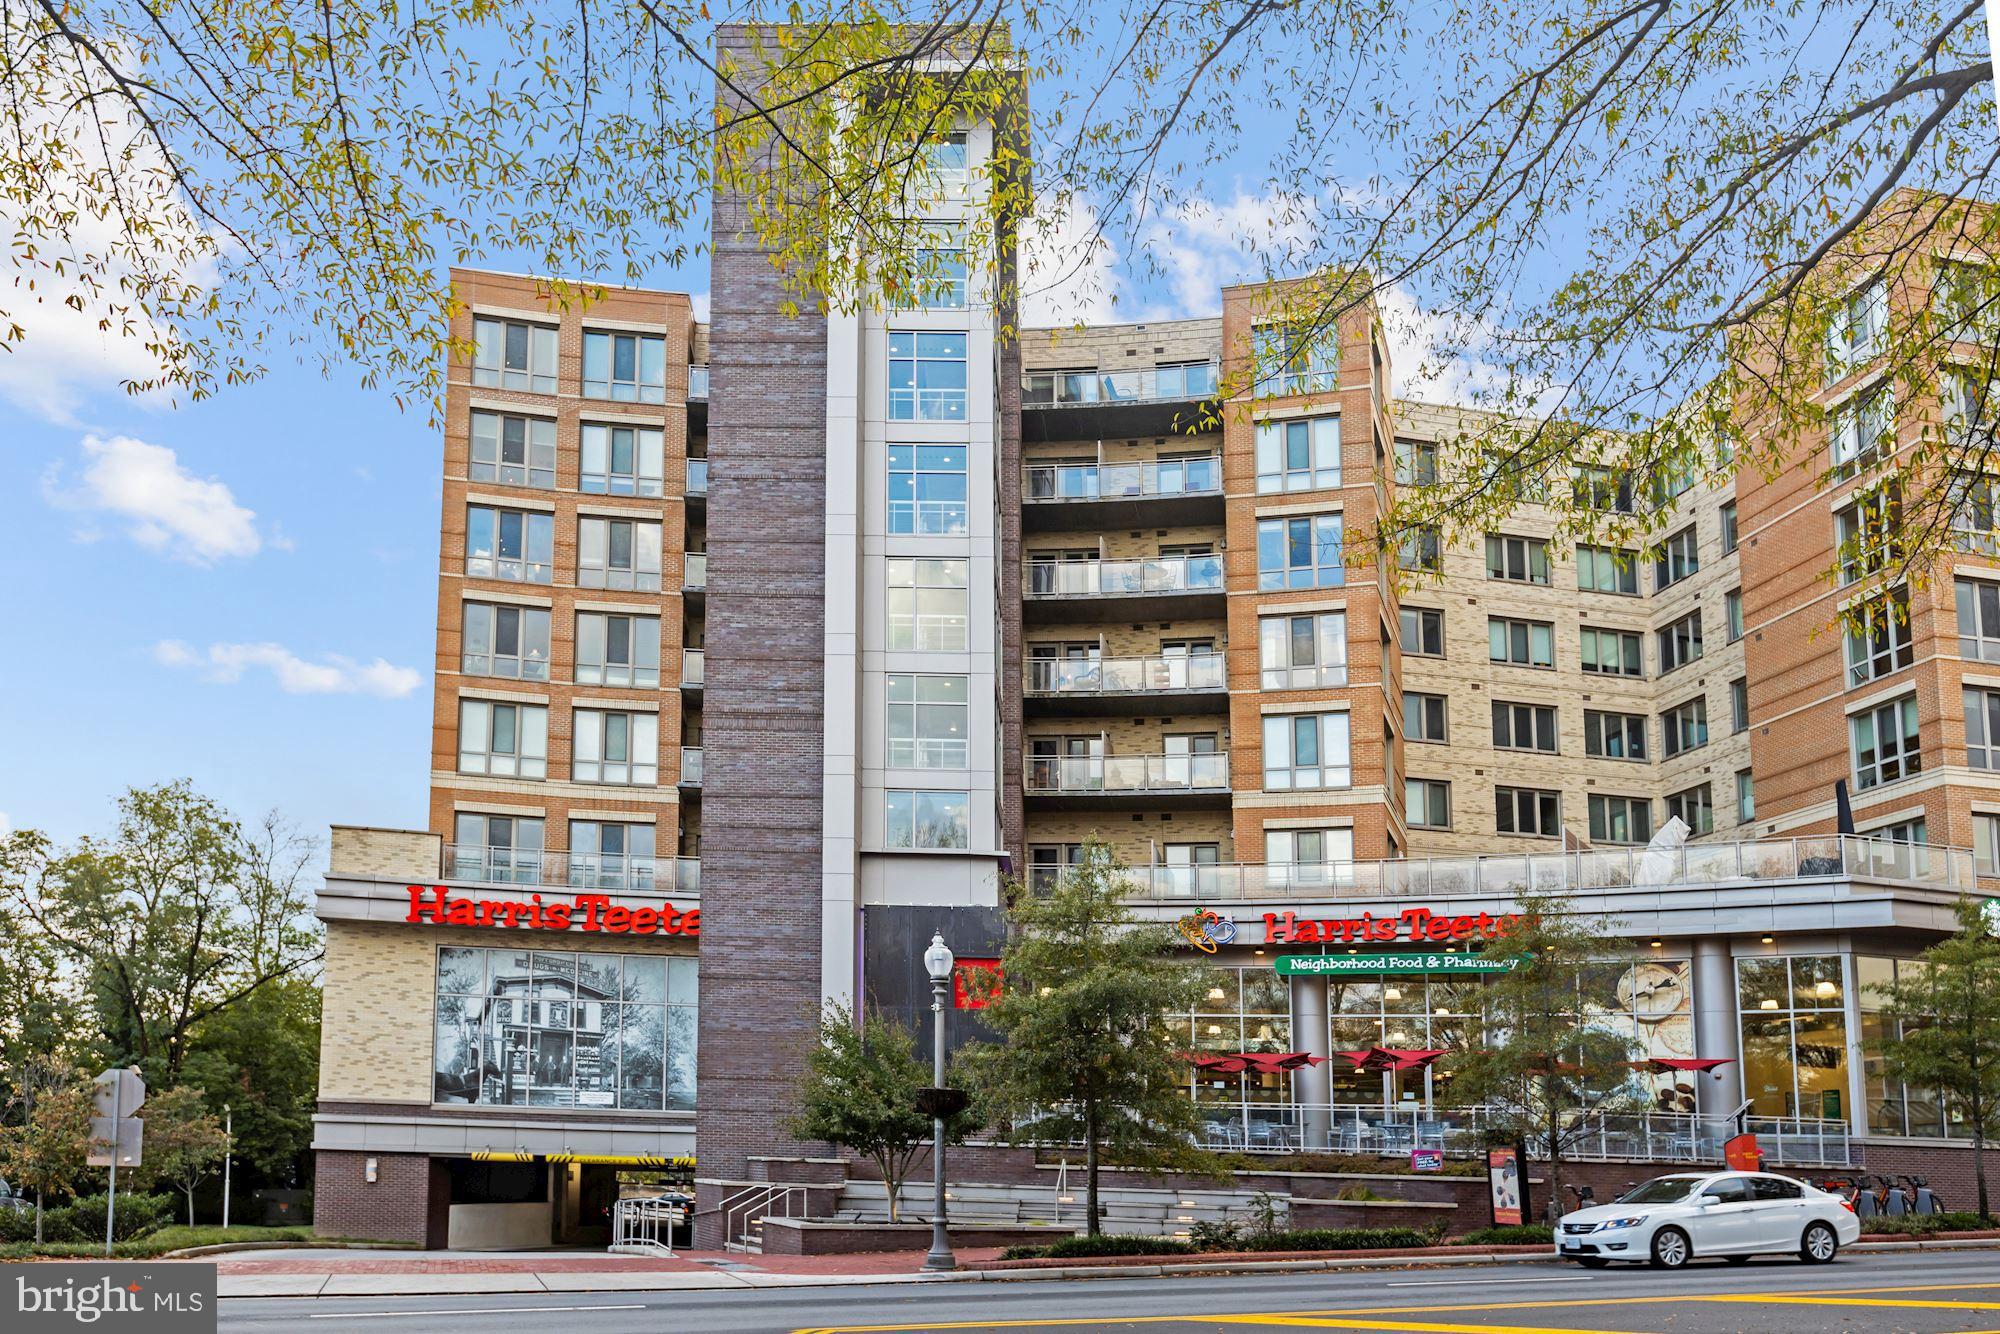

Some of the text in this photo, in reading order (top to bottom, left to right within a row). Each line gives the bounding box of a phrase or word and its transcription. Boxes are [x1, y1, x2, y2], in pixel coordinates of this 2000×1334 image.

[405, 885, 571, 929] Harris
[1263, 911, 1397, 943] Harris
[1290, 958, 1386, 972] Neighborhood
[1389, 956, 1423, 969] Food
[1426, 956, 1440, 968] &
